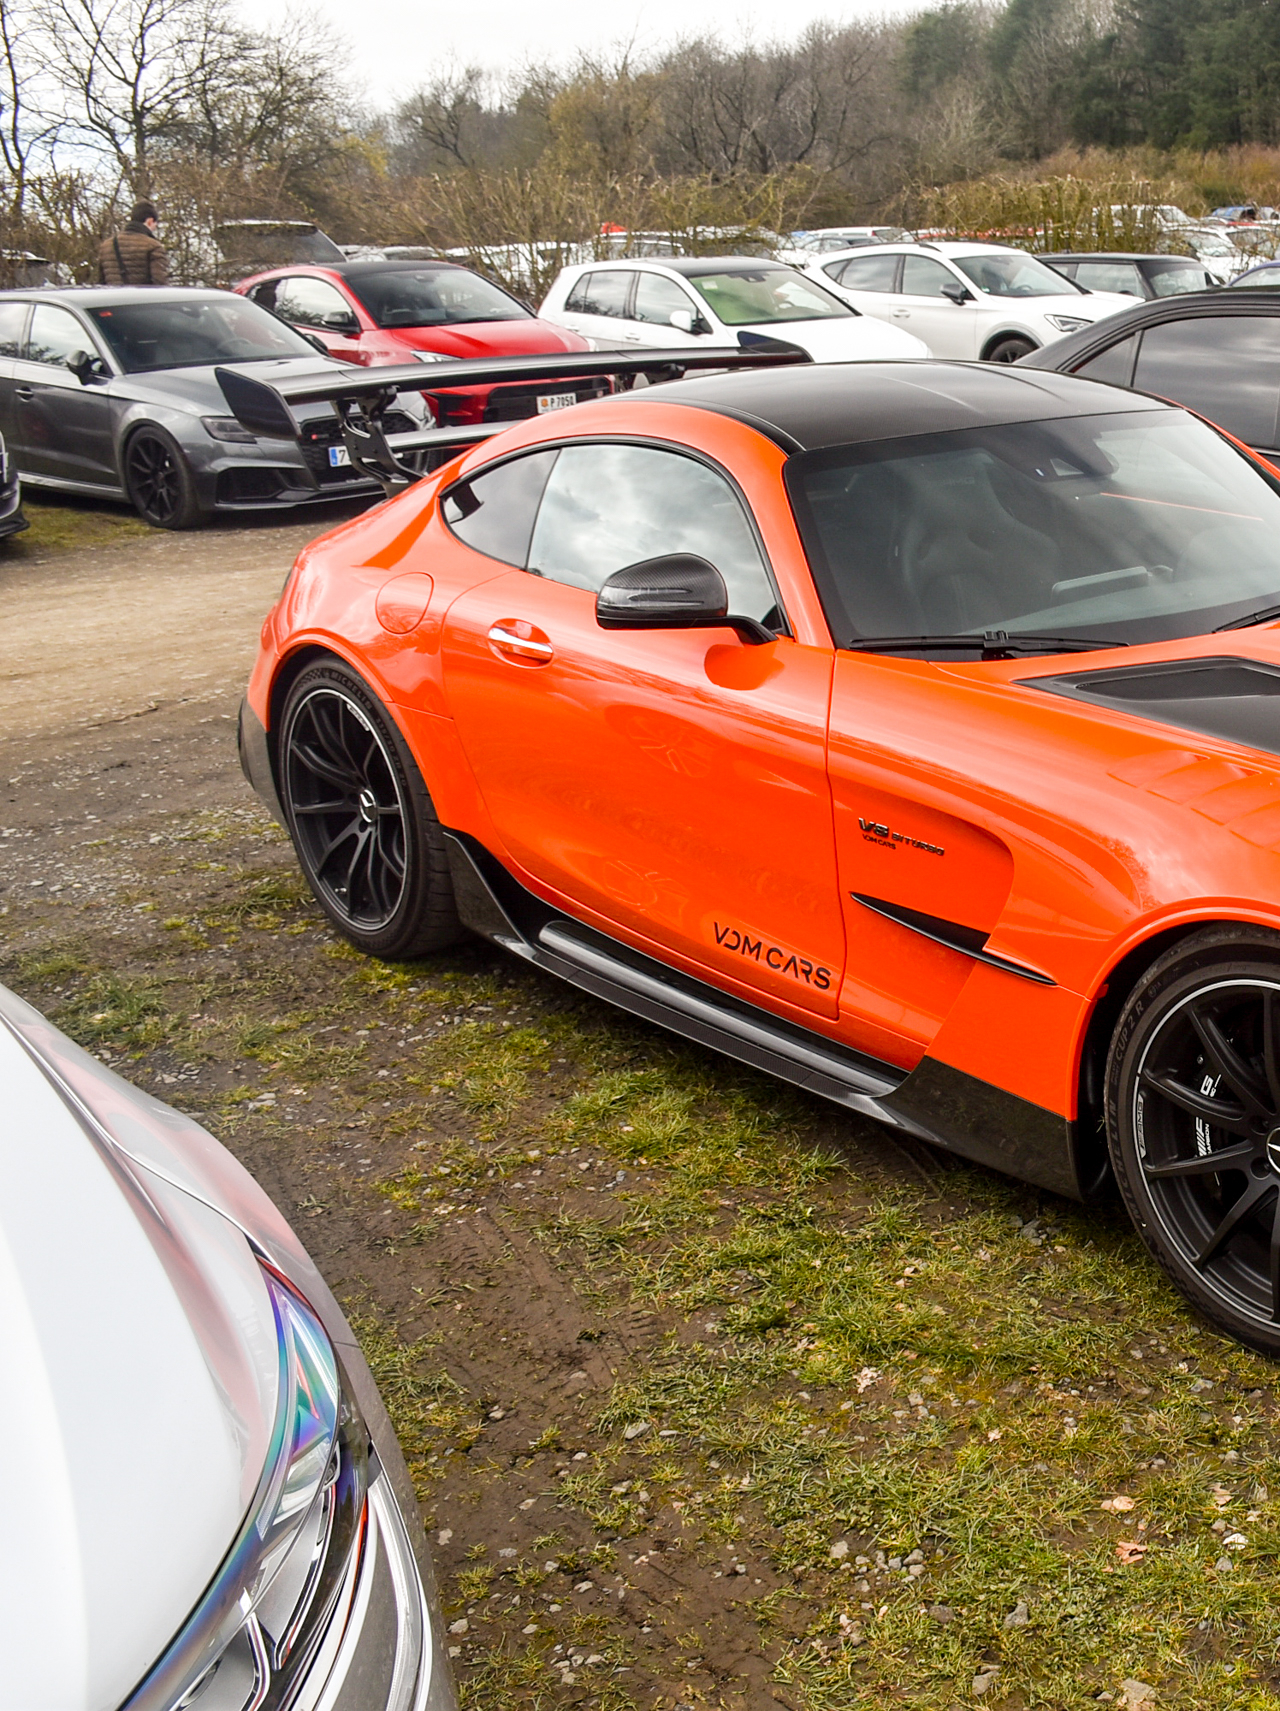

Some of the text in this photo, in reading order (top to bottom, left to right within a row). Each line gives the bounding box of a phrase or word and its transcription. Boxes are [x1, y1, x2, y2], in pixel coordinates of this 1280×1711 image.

[330, 671, 373, 710] MICHELIN
[858, 817, 945, 857] V8 BITURBO
[862, 833, 897, 850] VDM CARS
[714, 921, 831, 990] VDM CARS
[1116, 1000, 1144, 1061] CUP 2 R
[1108, 1100, 1142, 1221] MICHELIN
